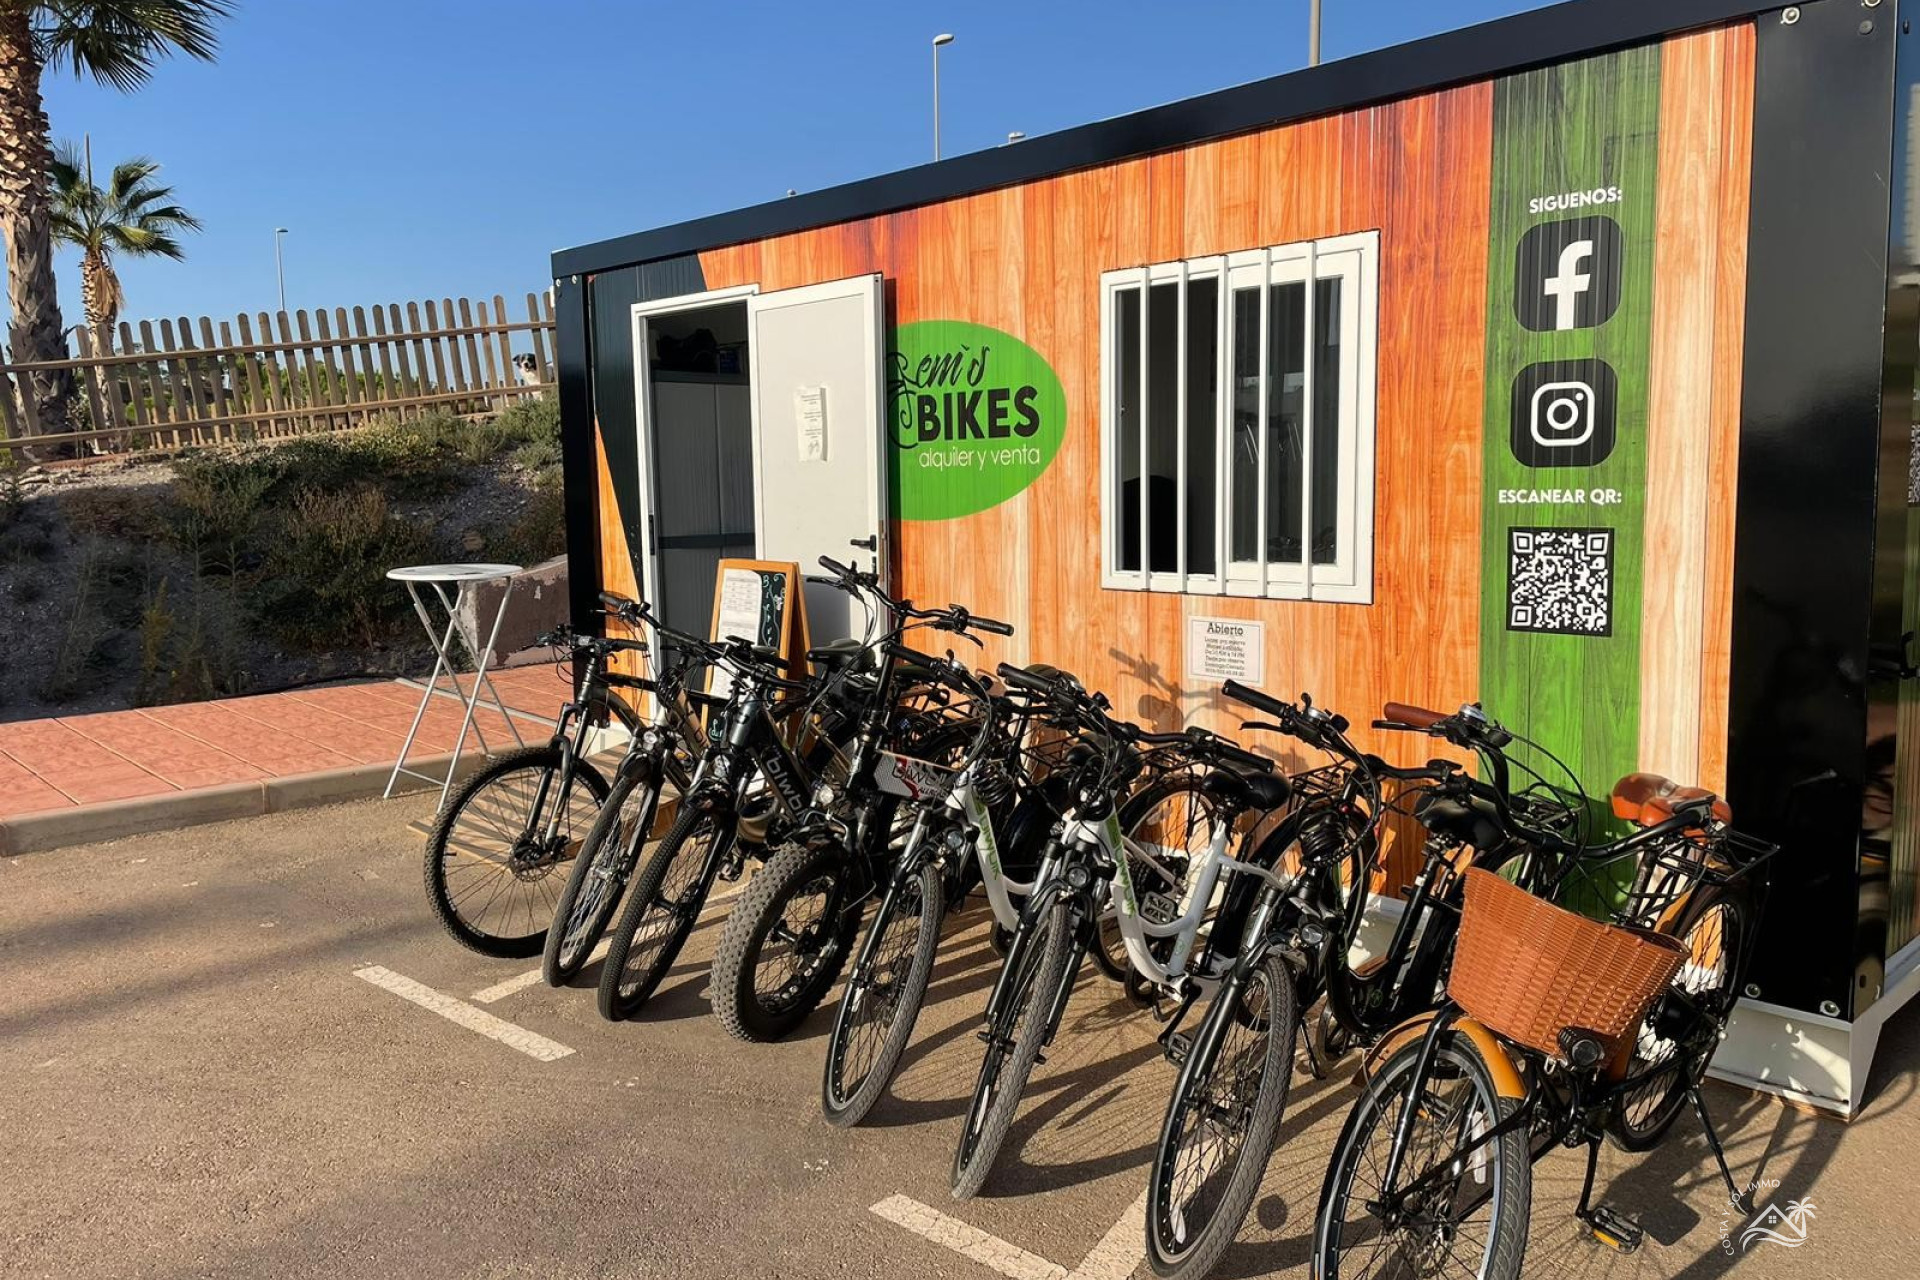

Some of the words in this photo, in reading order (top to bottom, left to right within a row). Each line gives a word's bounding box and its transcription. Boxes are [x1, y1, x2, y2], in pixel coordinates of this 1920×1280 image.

[1529, 187, 1623, 214] SIGUENOS:
[918, 386, 1041, 442] BIKES
[919, 446, 974, 471] alquiler
[977, 450, 987, 471] y
[990, 444, 1040, 467] venta
[1498, 489, 1586, 505] ESCANEAR
[1590, 489, 1623, 505] QR:
[1207, 622, 1244, 635] Abierto
